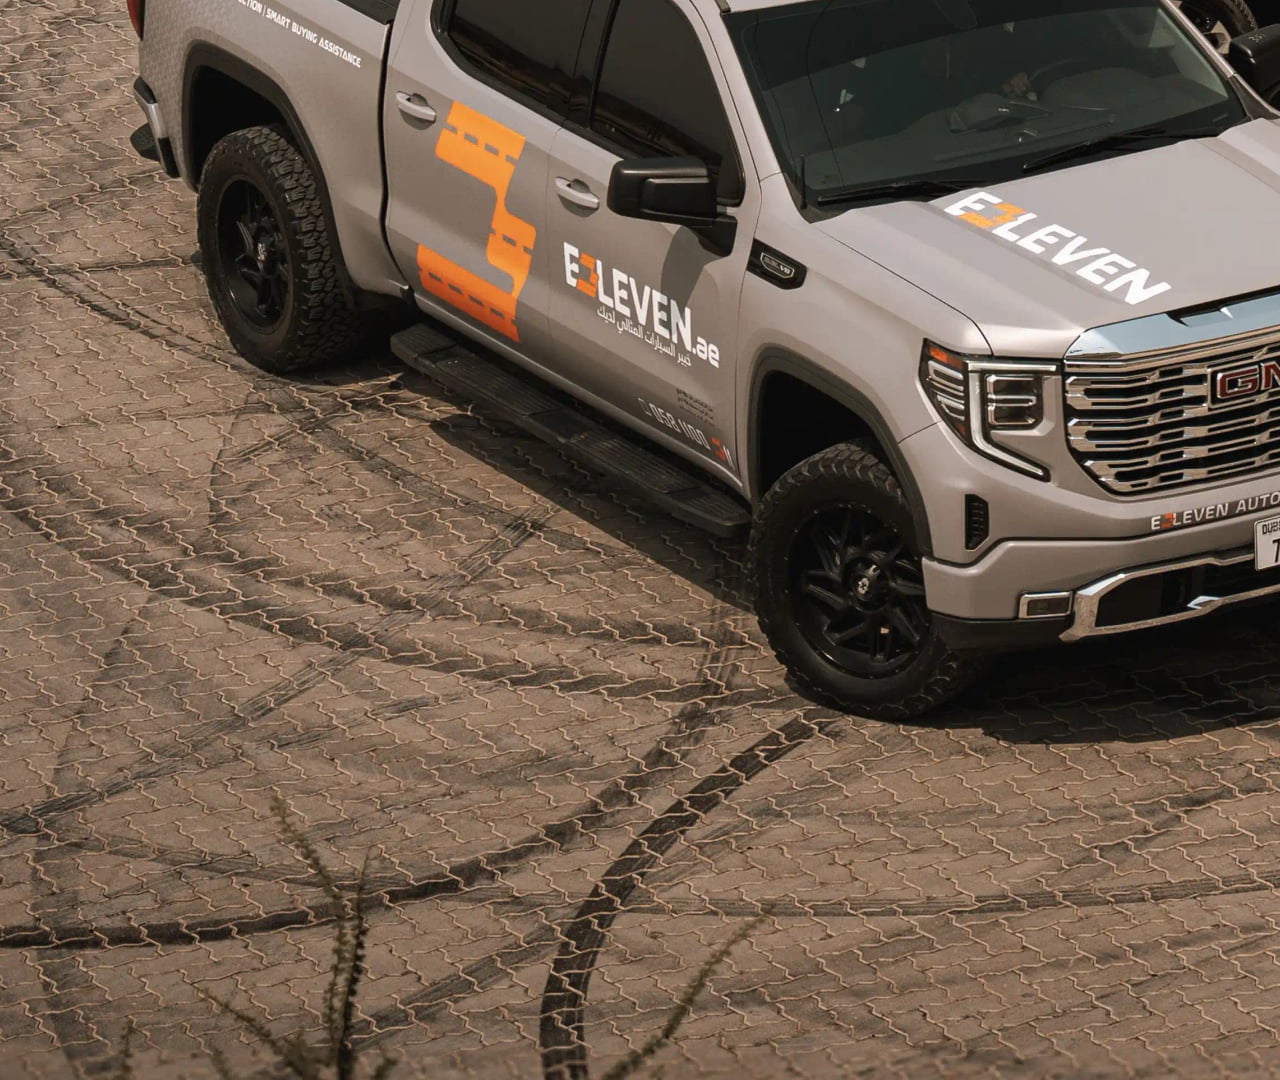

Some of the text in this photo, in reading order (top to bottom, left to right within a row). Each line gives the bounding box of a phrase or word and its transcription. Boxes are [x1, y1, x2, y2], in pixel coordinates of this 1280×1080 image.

[266, 7, 291, 29] SMART
[292, 24, 318, 44] BUYING
[319, 37, 361, 68] ASSISTANCE
[596, 304, 616, 324] لديك
[644, 331, 676, 357] السيارات
[677, 352, 692, 367] خبير
[648, 403, 682, 433] 058
